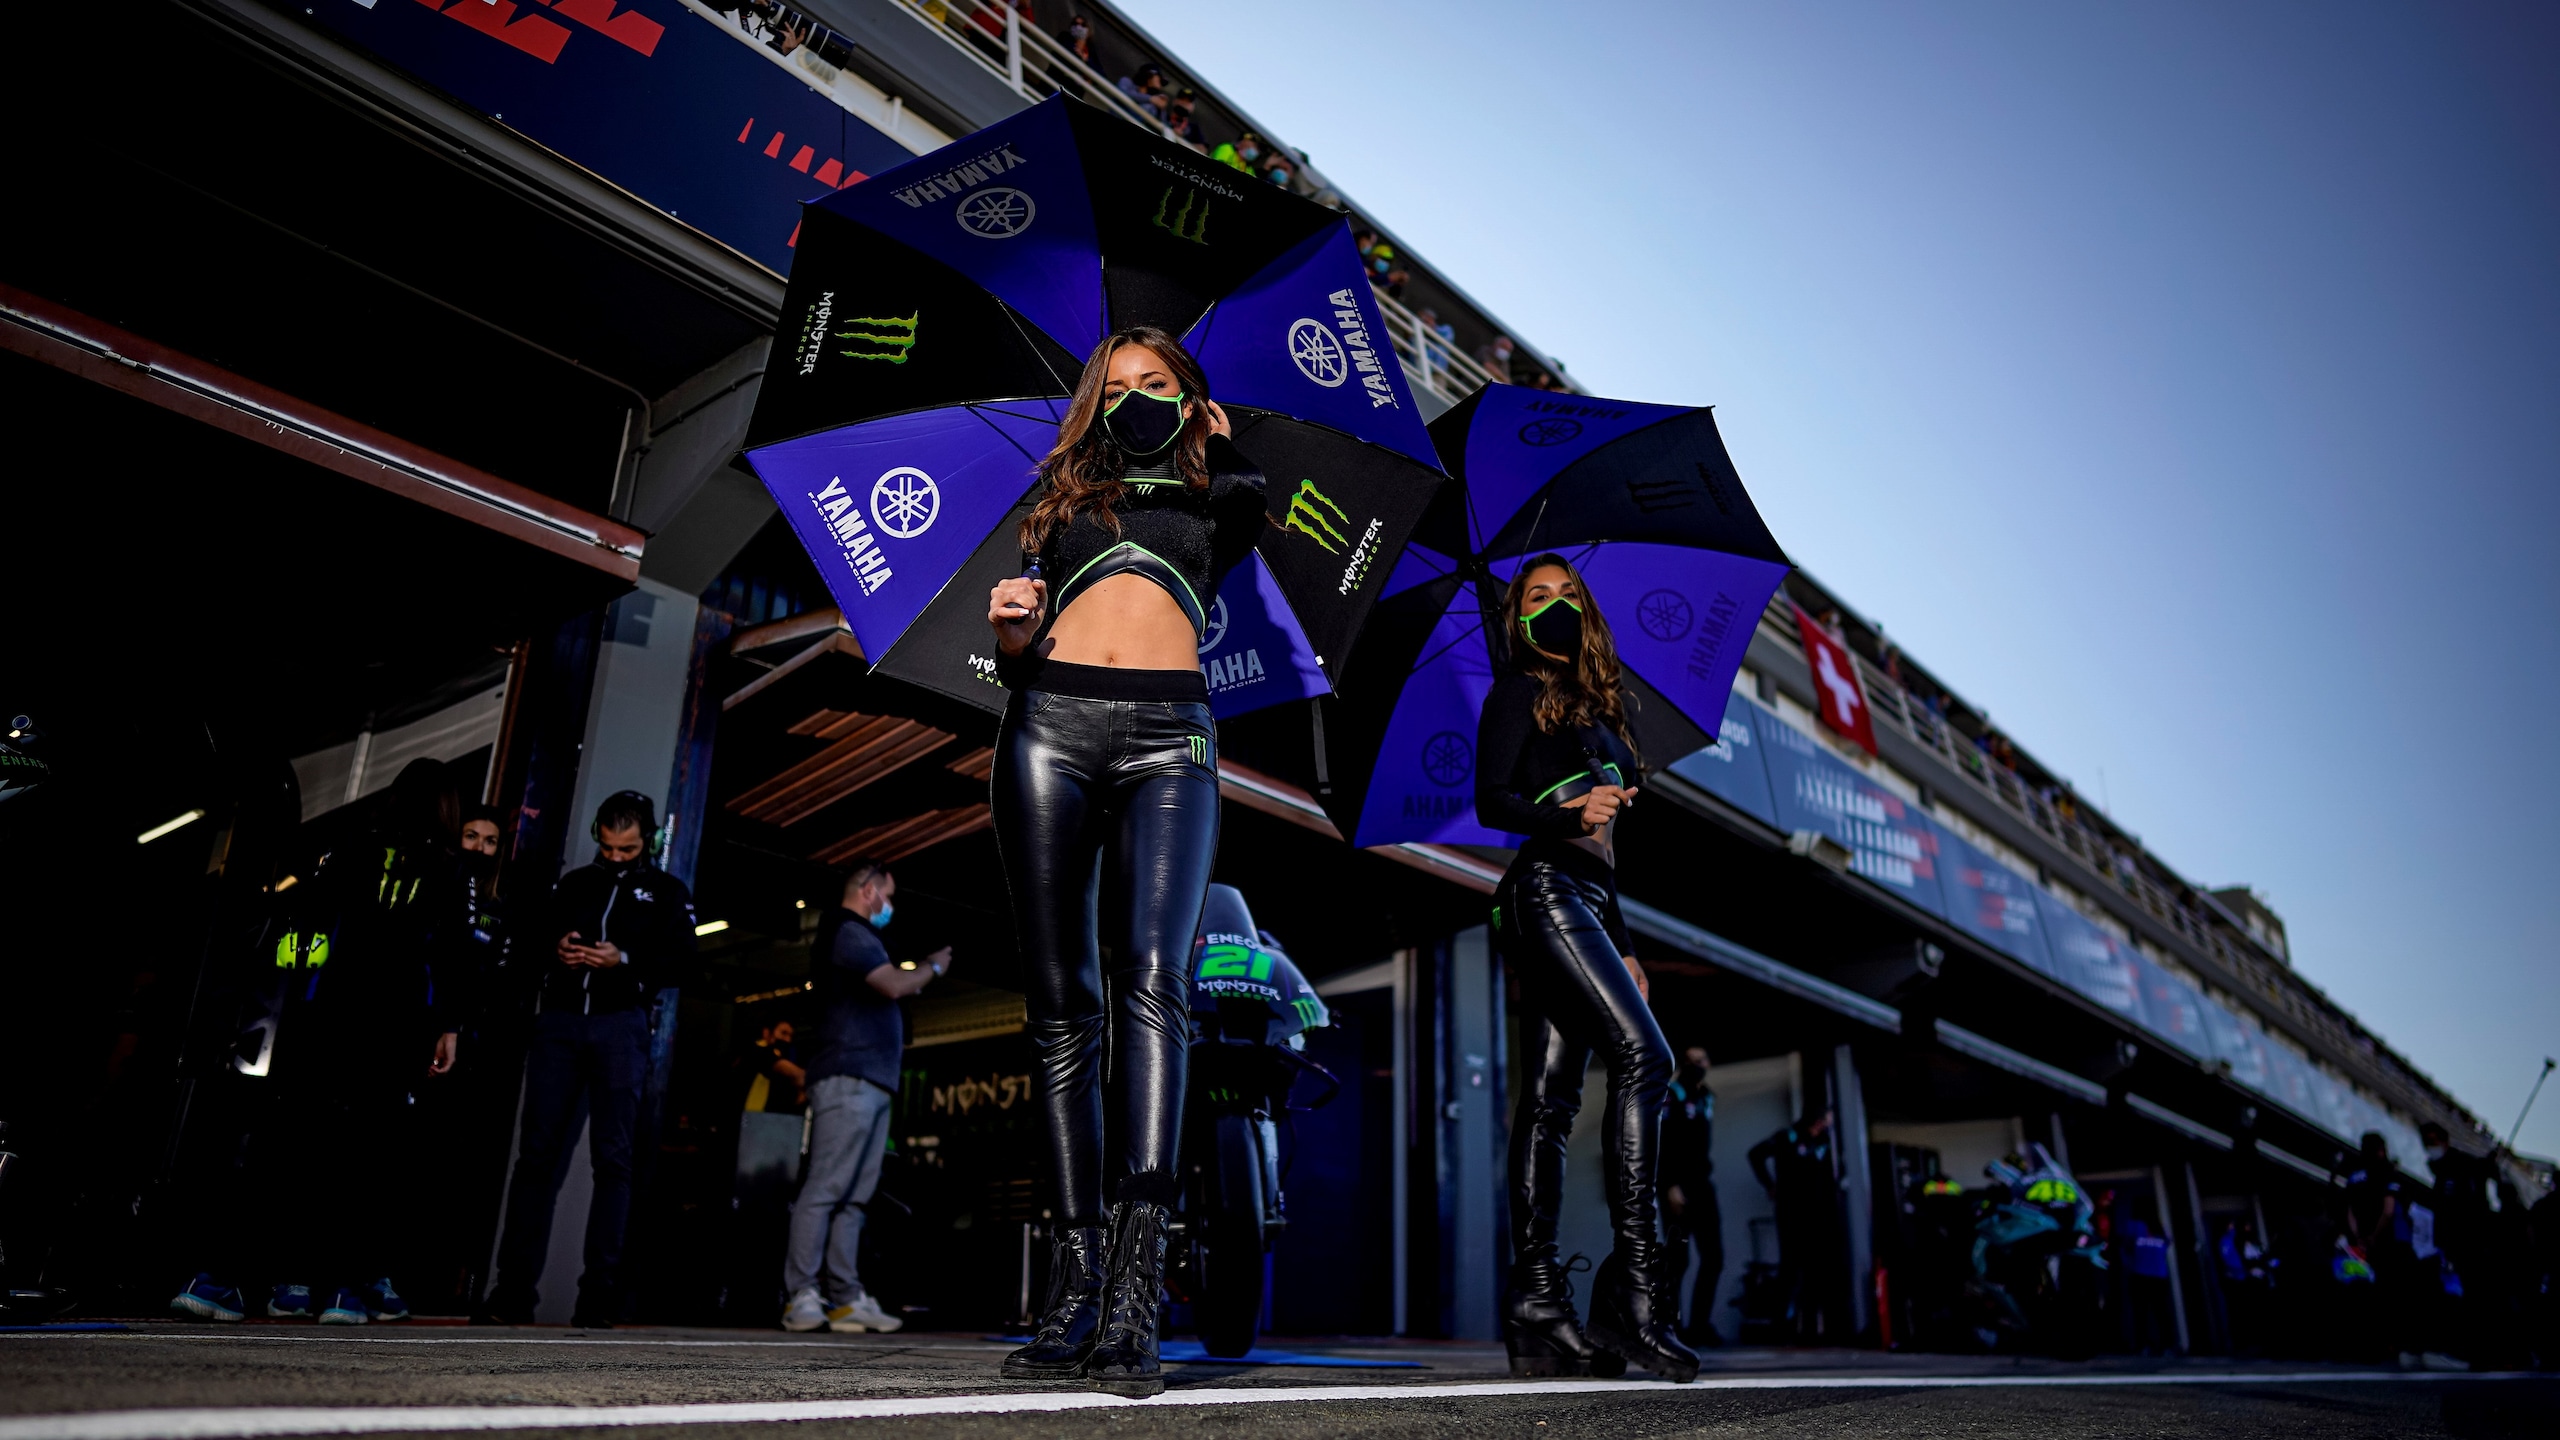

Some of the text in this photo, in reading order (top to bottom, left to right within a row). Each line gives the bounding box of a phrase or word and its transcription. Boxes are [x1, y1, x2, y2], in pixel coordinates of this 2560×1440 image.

[893, 149, 1028, 208] YAMAHA
[1150, 154, 1244, 202] MONSTER
[795, 304, 816, 363] ENERGY
[800, 291, 834, 376] MONSTER
[1328, 288, 1392, 409] YAMAHA
[807, 491, 870, 598] FACTORY RACING
[816, 475, 893, 594] YAMAHA
[1338, 517, 1383, 596] MONSTER
[1353, 536, 1382, 591] ENERGY
[1218, 675, 1266, 693] RACING
[1196, 943, 1275, 983] 21
[1196, 979, 1282, 1002] MONSTER
